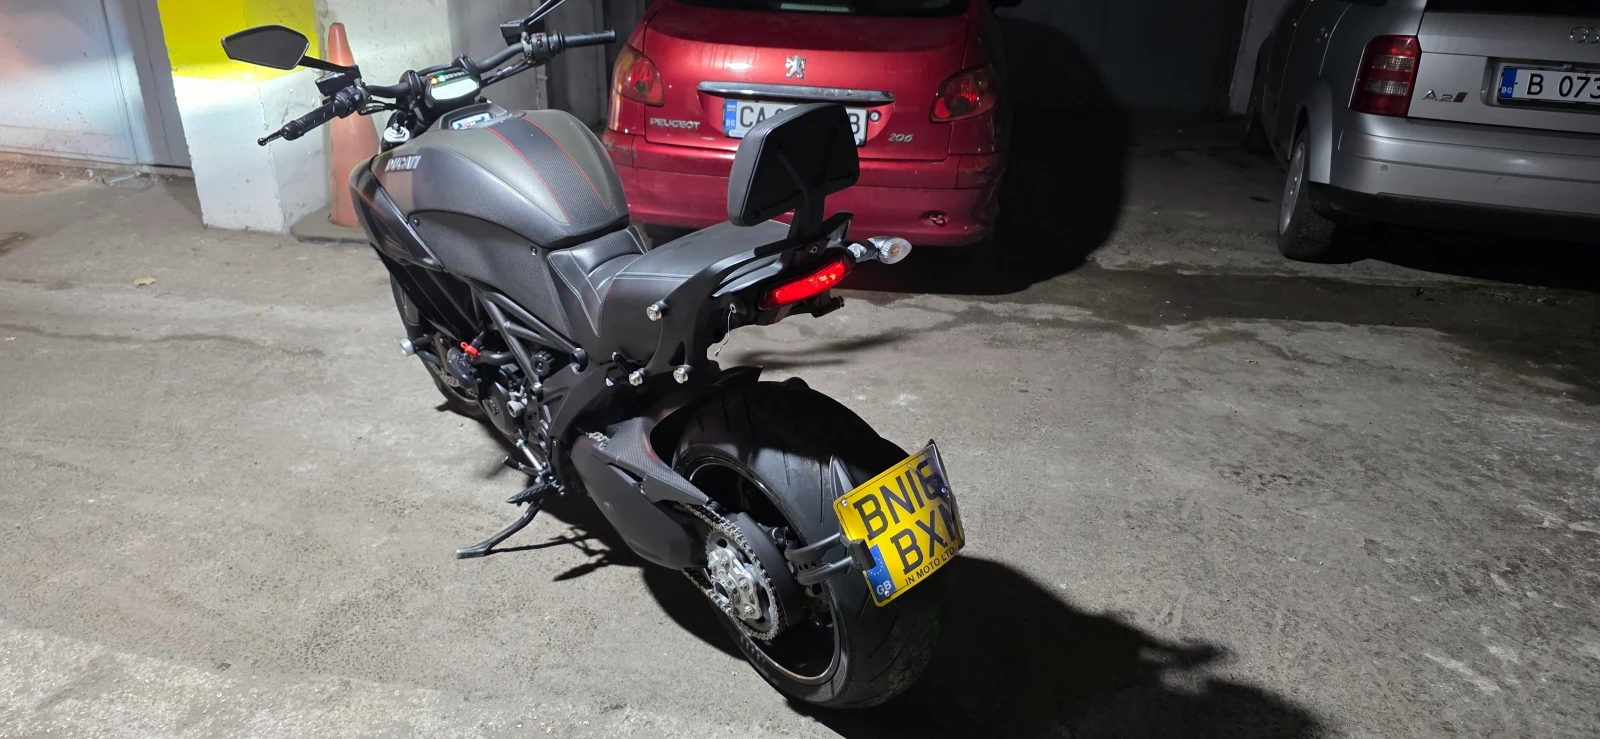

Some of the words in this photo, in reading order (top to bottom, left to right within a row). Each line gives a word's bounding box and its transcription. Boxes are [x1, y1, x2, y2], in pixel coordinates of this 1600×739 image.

[1501, 86, 1513, 94] BG
[1527, 73, 1544, 95] B
[1558, 75, 1600, 98] 073
[650, 117, 700, 129] PEUGEOT
[725, 119, 736, 127] BG
[888, 133, 914, 143] 206
[385, 155, 421, 171] DUCATI
[915, 557, 940, 579] MOTO
[876, 580, 892, 595] GB
